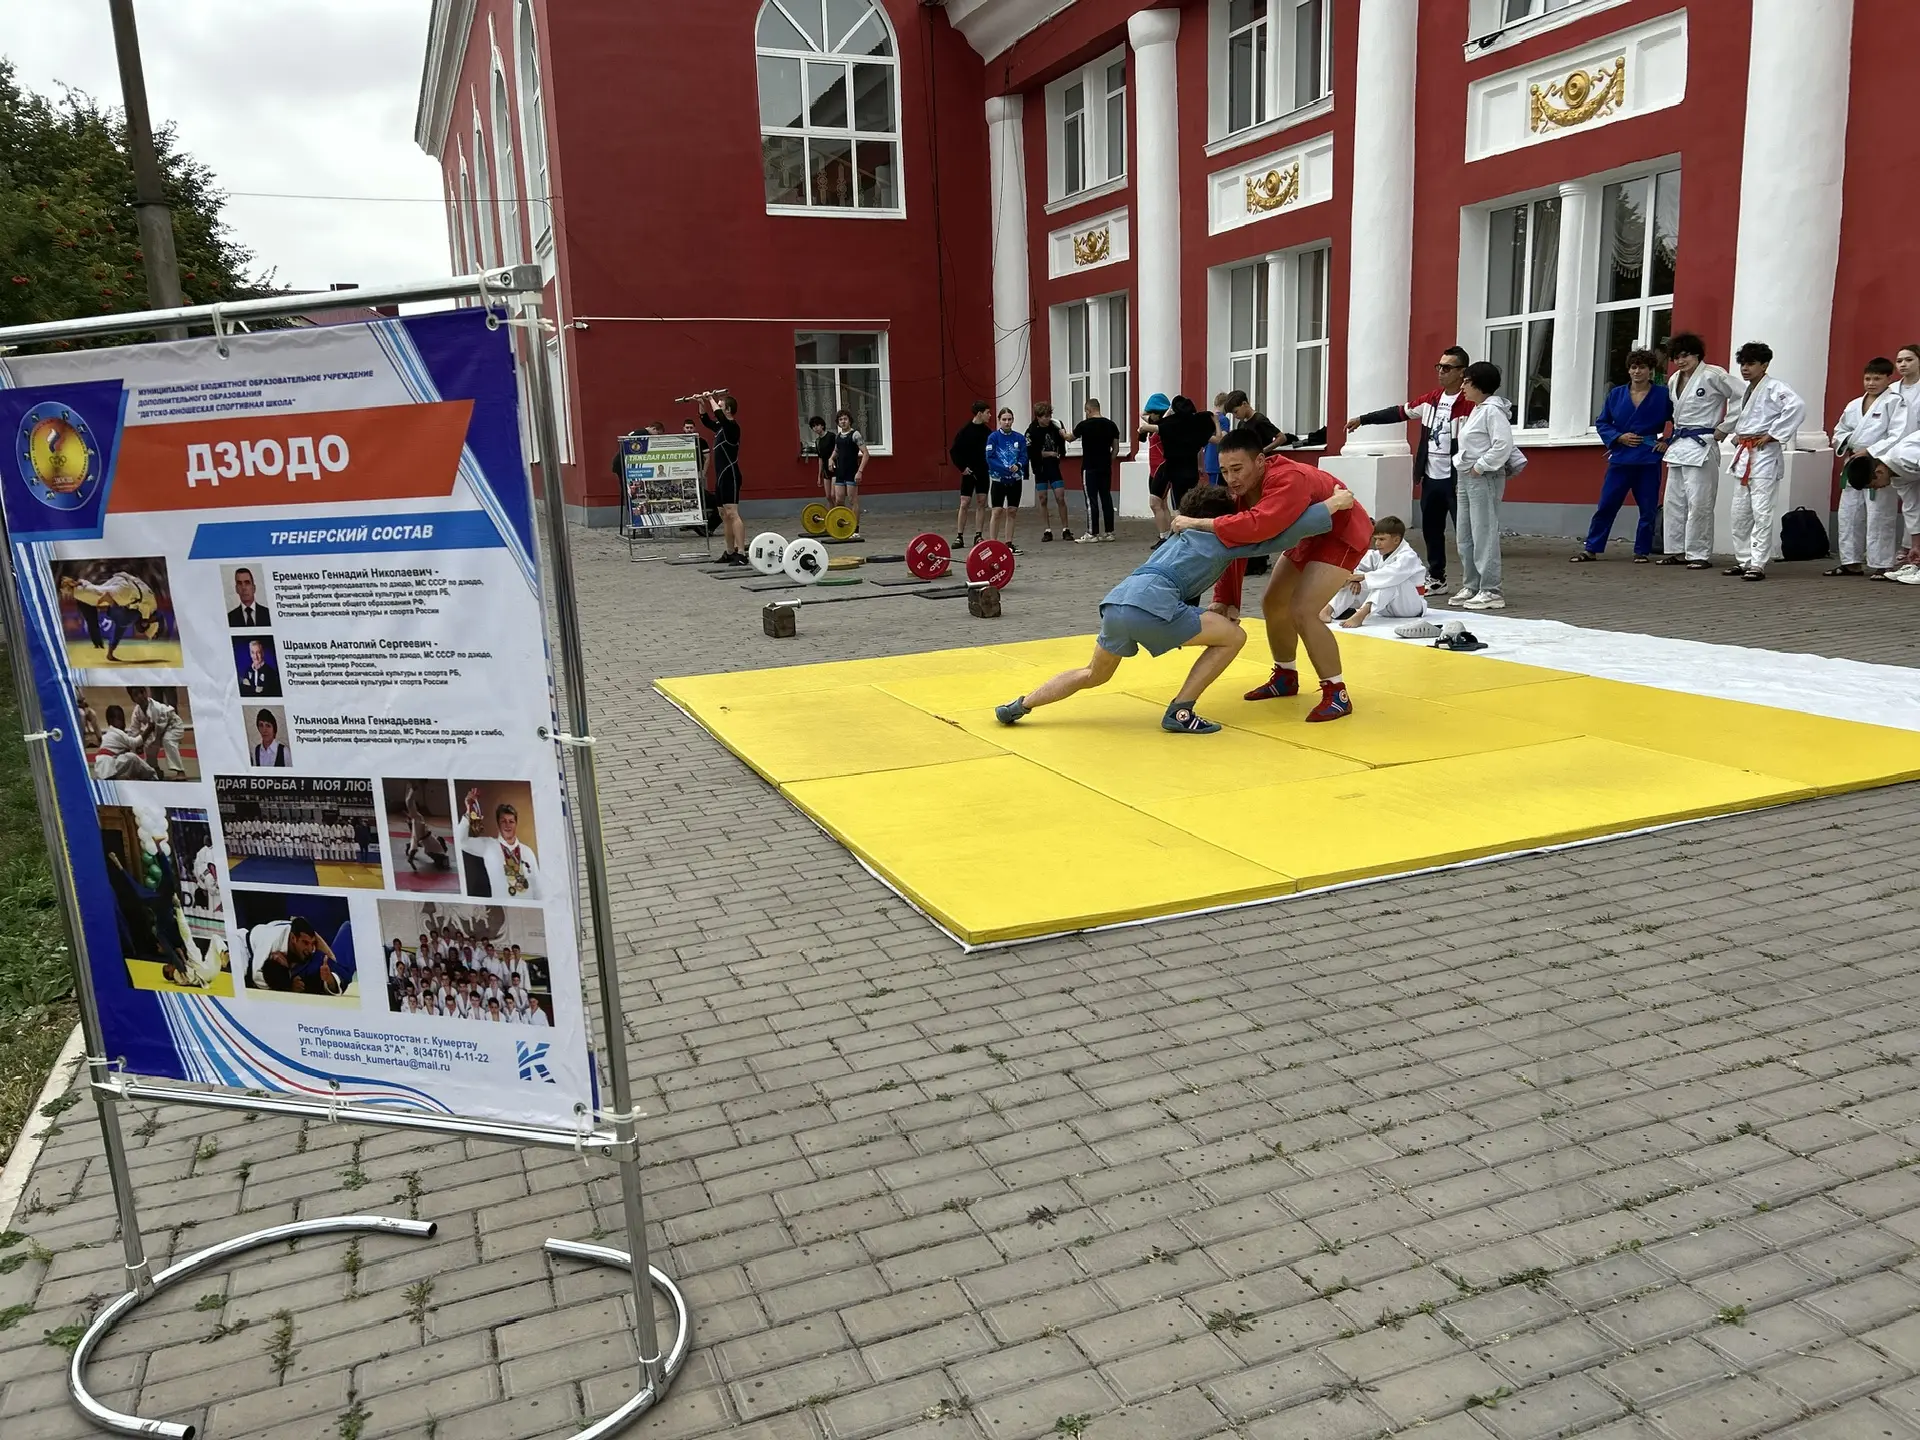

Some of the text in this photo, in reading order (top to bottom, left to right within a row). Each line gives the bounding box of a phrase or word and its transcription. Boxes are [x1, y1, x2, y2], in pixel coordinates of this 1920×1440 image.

[138, 370, 374, 396] МУНИЦИПАЛЬНОЕ БЮДЖЕТНОЕ ОБРАЗОВАТЕЛЬНОЕ УЧРЕЖДЕНИЕ
[138, 390, 262, 407] ДОПОЛНИТЕЛЬНОГО ОБРАЗОВАНИЯ
[216, 401, 264, 411] СПОРТИВНАЯ
[266, 398, 296, 407] ШКОЛА"
[186, 434, 350, 488] ДЗЮДО
[270, 525, 433, 545] ТРЕНЕРСКИЙ СОСТАВ
[272, 571, 319, 582] Еременко
[322, 569, 368, 580] Геннадий
[371, 568, 432, 578] Николаевич
[304, 582, 378, 590] тренер-преподаватель
[276, 593, 300, 601] Лучший
[302, 592, 332, 600] работник
[334, 590, 373, 599] физической
[415, 589, 438, 597] спорта
[439, 588, 450, 596] РБ,
[311, 600, 341, 609] работник
[368, 599, 411, 607] образования
[310, 609, 350, 617] физической
[351, 609, 382, 617] культуры
[283, 640, 327, 651] Шрамков
[330, 639, 376, 649] Анатолий
[379, 639, 432, 650] Сергеевич
[293, 715, 339, 725] Ульянова
[341, 715, 366, 725] Инна
[368, 716, 431, 726] Геннадьевна
[296, 736, 321, 744] Лучший
[322, 736, 352, 744] работник
[250, 778, 297, 790] БОРЬБА
[313, 780, 340, 790] МОЯ
[298, 1023, 351, 1036] Республика
[354, 1029, 421, 1043] Башкортостан
[432, 1036, 478, 1051] Кумертау
[299, 1037, 313, 1046] ул.
[315, 1037, 382, 1052] Первомайская
[414, 1046, 452, 1062] 8(34761)
[454, 1051, 489, 1063] 4-11-22
[301, 1048, 450, 1071] E-mail: dussh_kumertau@mail.ru
